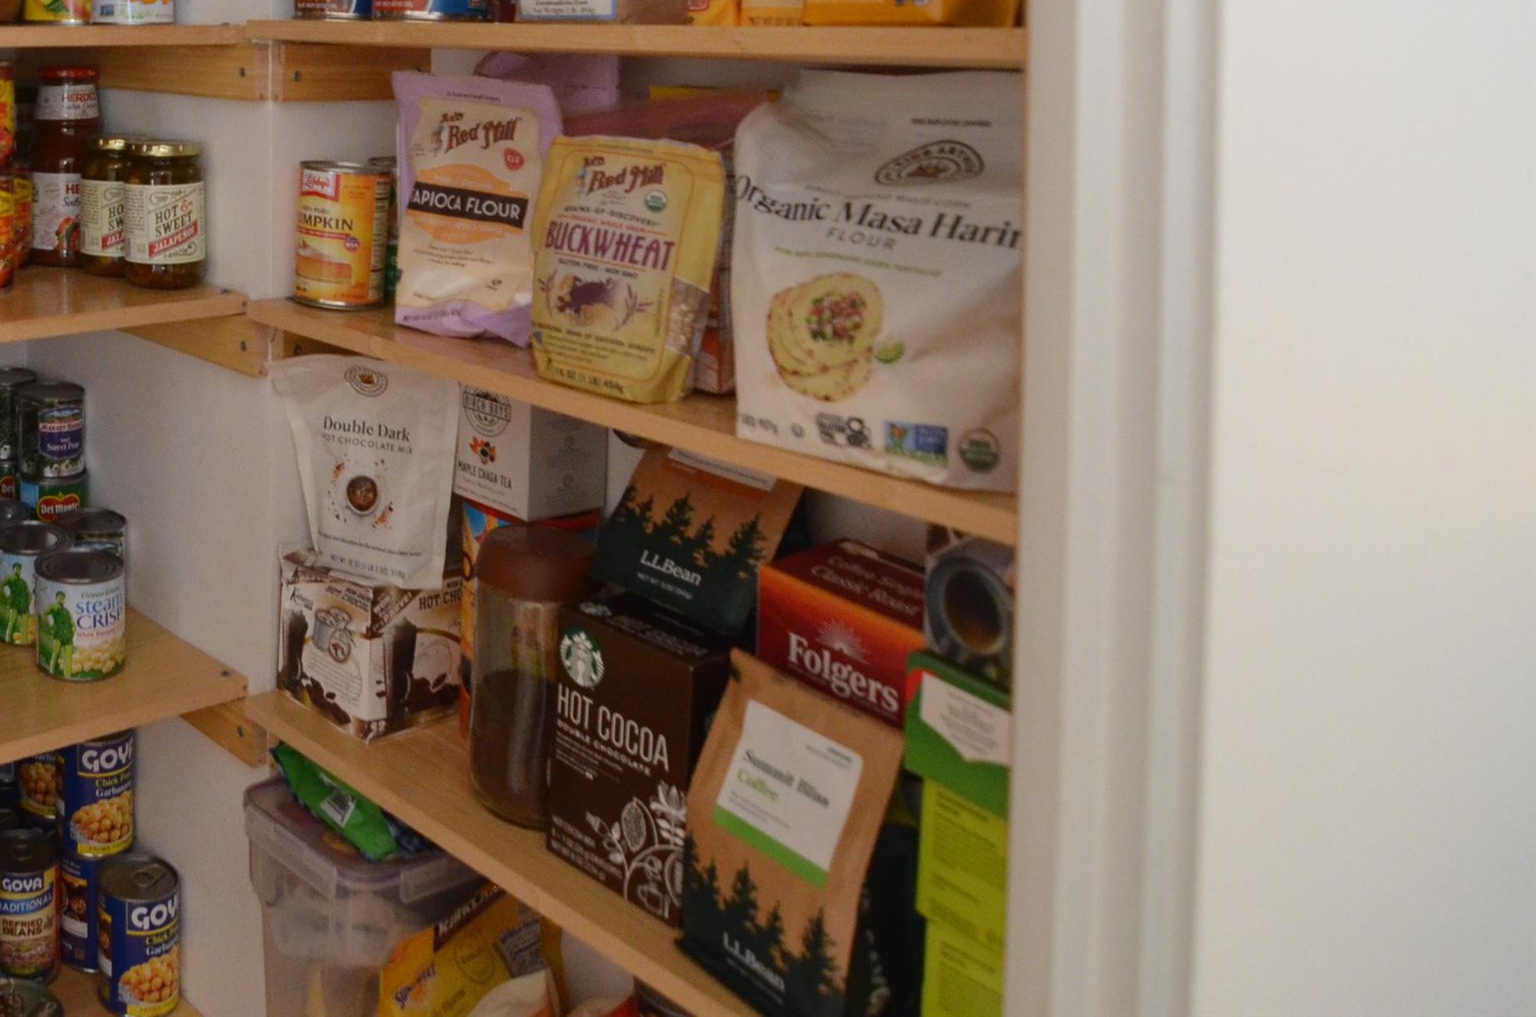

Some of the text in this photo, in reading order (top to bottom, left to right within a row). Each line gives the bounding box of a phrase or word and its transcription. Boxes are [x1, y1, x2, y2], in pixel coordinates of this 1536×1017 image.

[446, 117, 520, 153] Red Mill
[586, 162, 667, 197] Red Mill
[154, 198, 194, 224] HOT &
[413, 187, 522, 221] APIOCA FLOUR
[735, 173, 832, 223] Organic
[833, 201, 923, 236] Masa
[155, 211, 193, 236] SWEET
[297, 212, 354, 232] UMPKIN
[544, 220, 676, 272] BUCKWHEAT
[826, 227, 897, 251] FLOUR
[322, 414, 411, 444] Double Dark
[338, 435, 414, 456] CHOCOLATE MIX
[499, 473, 513, 491] TEA
[40, 501, 80, 515] Del Monte
[75, 594, 124, 616] steam
[419, 591, 442, 612] HOT
[787, 631, 900, 713] Folgers
[556, 682, 670, 773] HOT COCOA
[592, 737, 652, 778] CHOCOLATE
[1, 876, 44, 894] GOYA
[1, 916, 45, 932] REFRIED
[129, 894, 179, 929] GOY
[2, 925, 45, 940] BEANS
